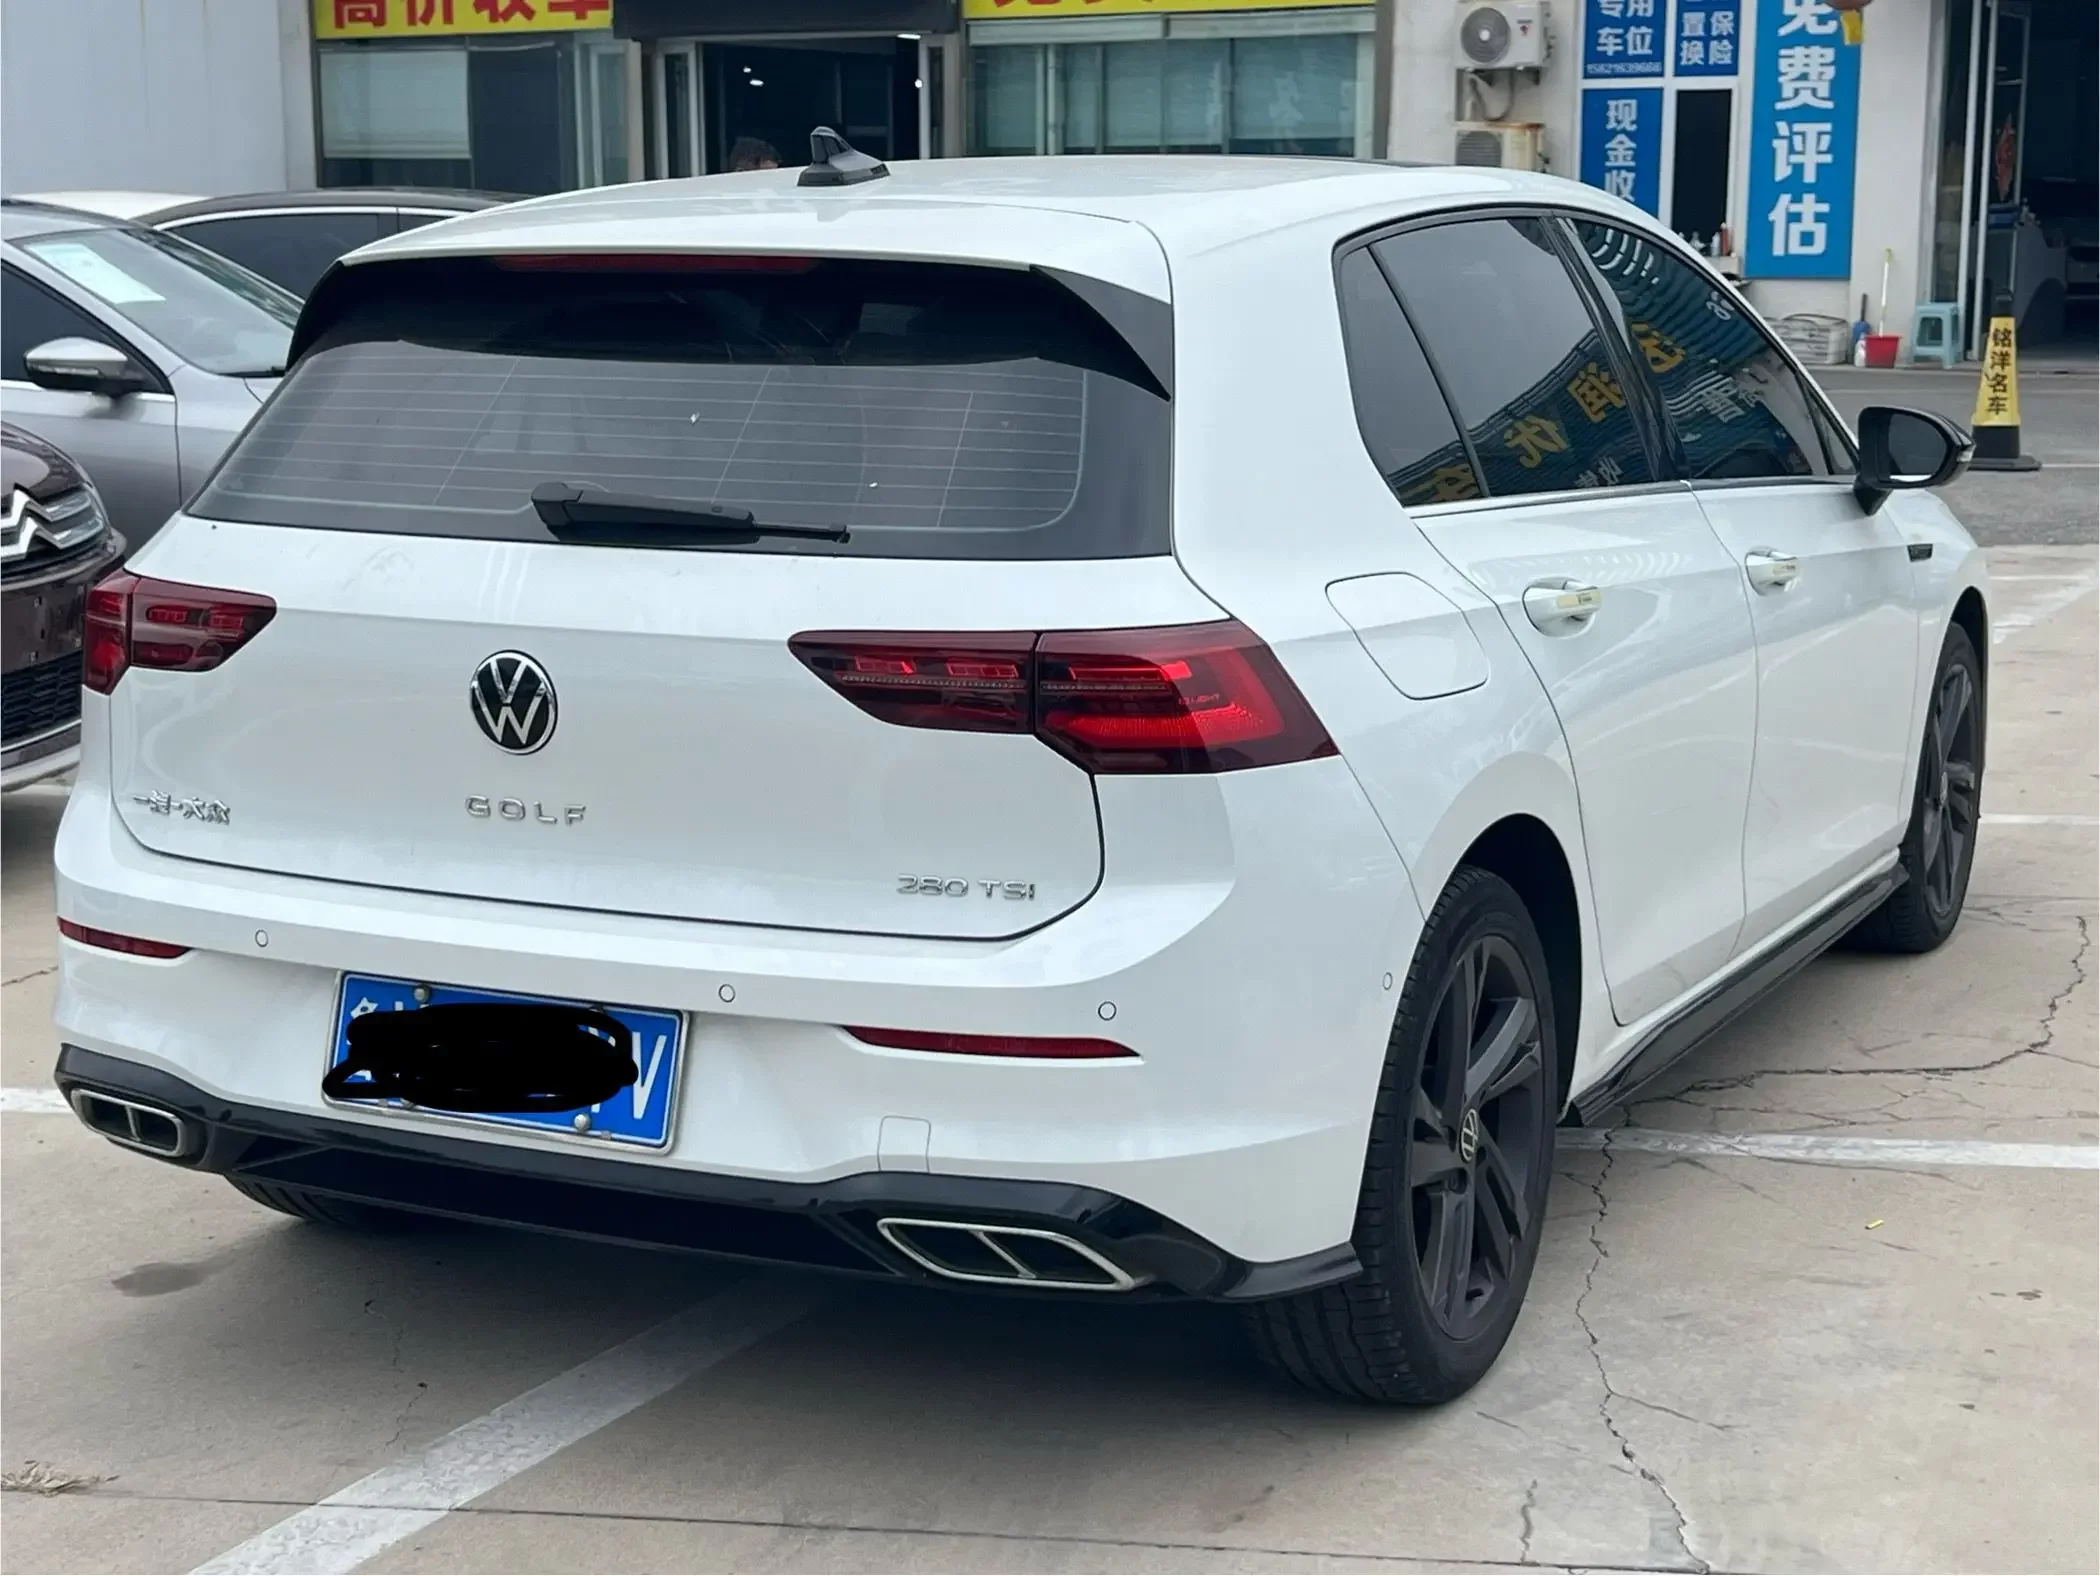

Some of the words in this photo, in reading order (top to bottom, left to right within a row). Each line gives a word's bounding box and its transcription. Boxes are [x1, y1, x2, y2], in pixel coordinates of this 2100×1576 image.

[1768, 0, 1838, 257] 免费评估
[1985, 327, 2012, 415] 铭洋名车
[465, 795, 587, 825] GOLF
[897, 874, 968, 897] 280
[977, 880, 1036, 900] TSI
